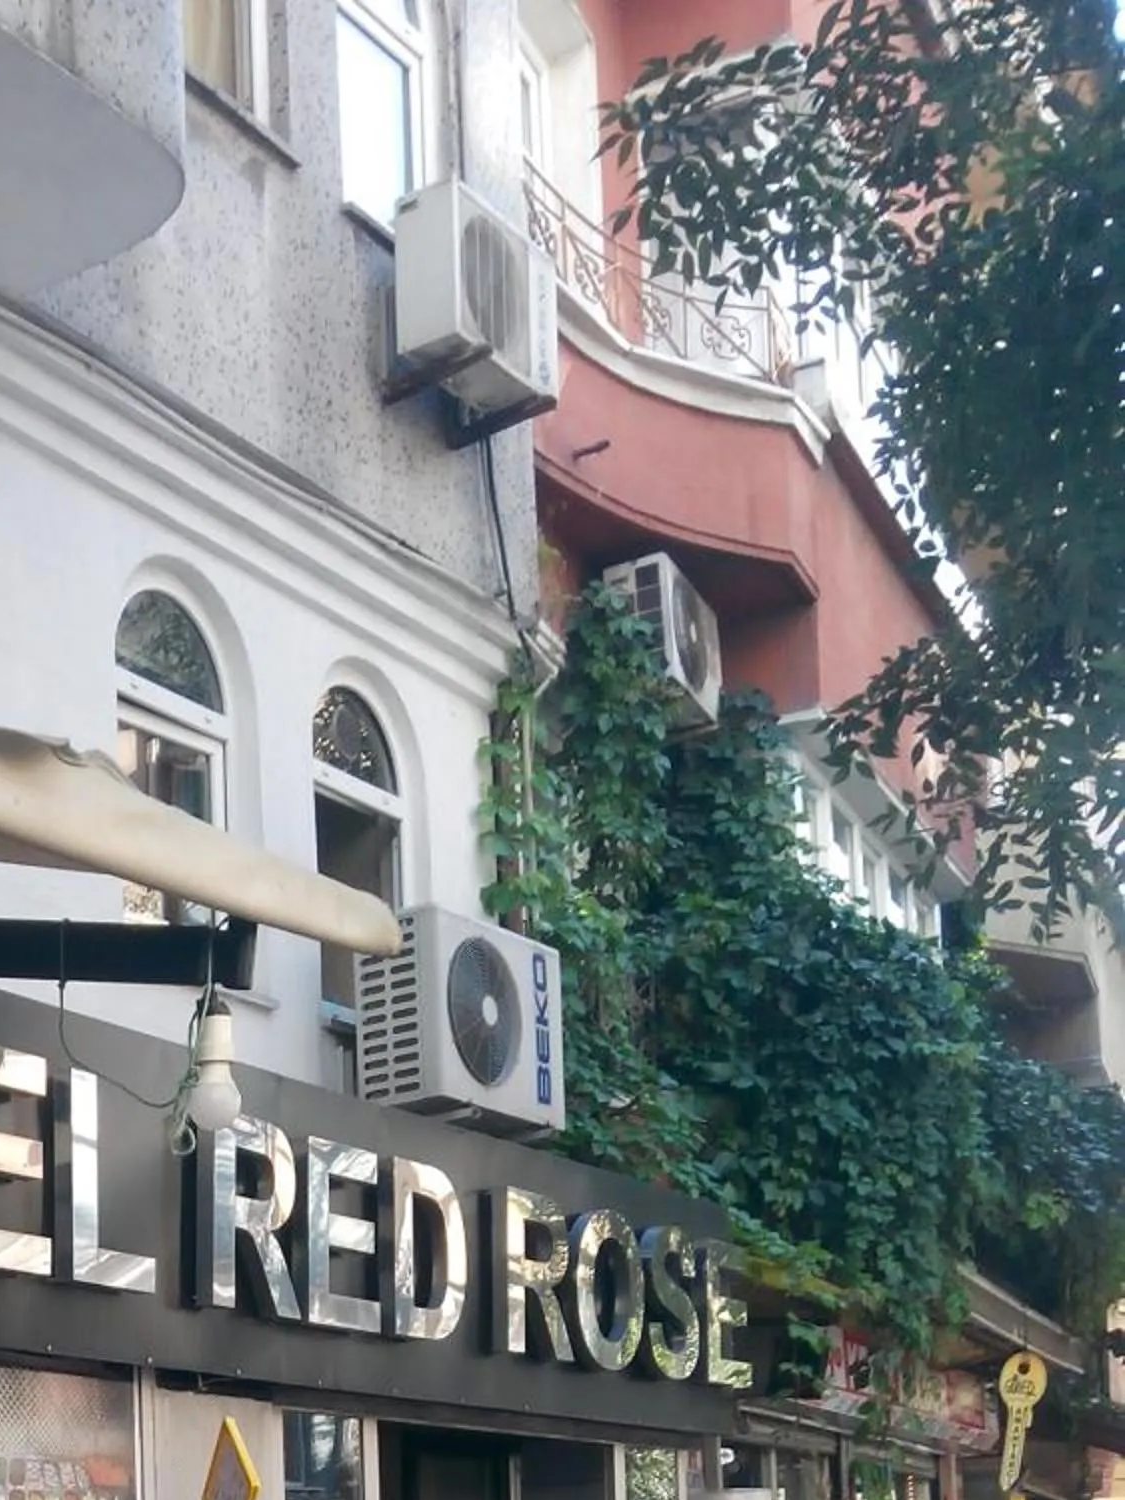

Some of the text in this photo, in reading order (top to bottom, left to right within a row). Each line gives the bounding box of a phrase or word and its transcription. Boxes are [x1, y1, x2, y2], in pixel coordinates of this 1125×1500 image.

[532, 953, 552, 1105] BEKO
[205, 1112, 469, 1341] RED
[505, 1186, 754, 1389] ROSE
